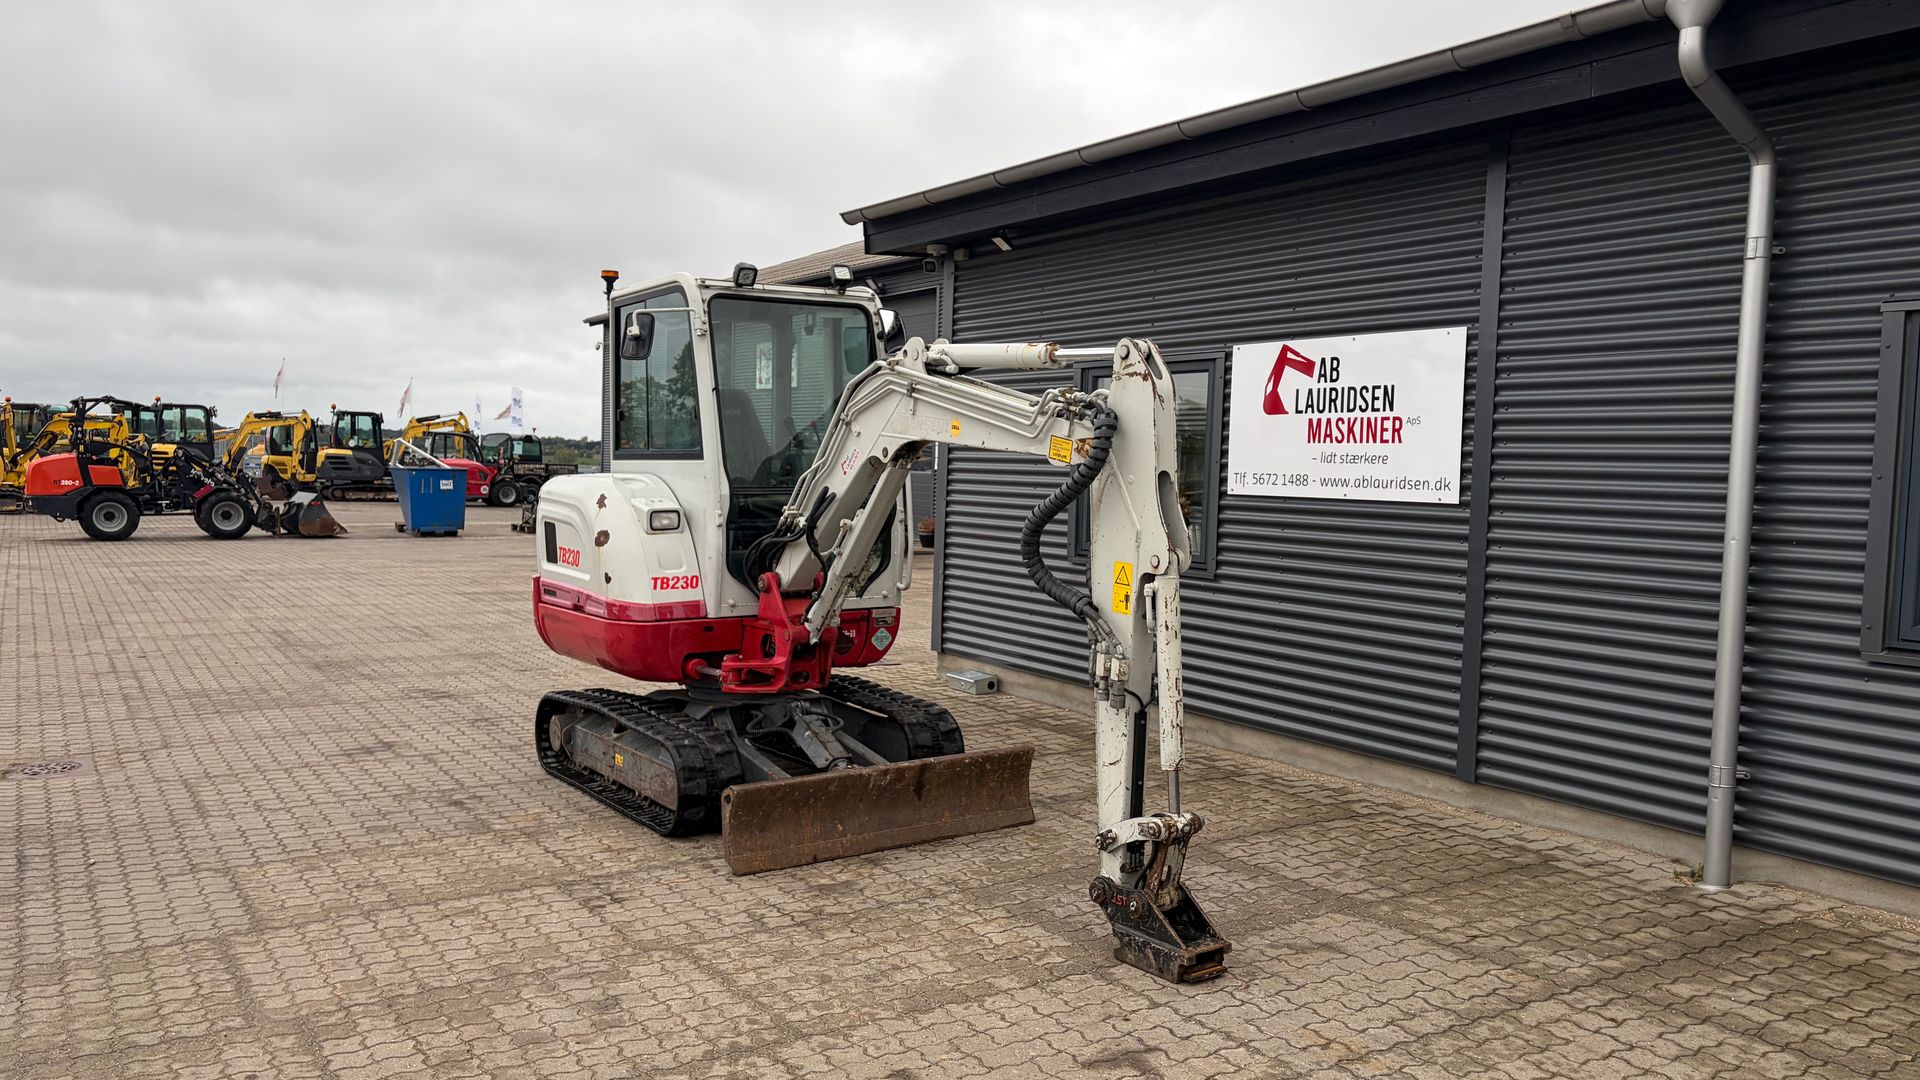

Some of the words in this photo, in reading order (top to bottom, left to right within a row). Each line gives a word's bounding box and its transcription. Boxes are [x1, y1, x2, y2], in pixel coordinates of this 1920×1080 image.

[1316, 356, 1341, 384] AB
[1294, 384, 1396, 415] LAURIDSEN
[1307, 415, 1404, 445] MASKINER
[1405, 415, 1422, 427] ApS
[1320, 451, 1338, 465] lidt
[1339, 451, 1389, 466] stærkere
[1233, 471, 1250, 487] Tlf.
[1252, 472, 1279, 487] 5672
[1281, 473, 1309, 487] 1488
[1319, 474, 1452, 492] www.ablauridsen.dk
[558, 546, 581, 567] TB230
[651, 575, 700, 591] TB230
